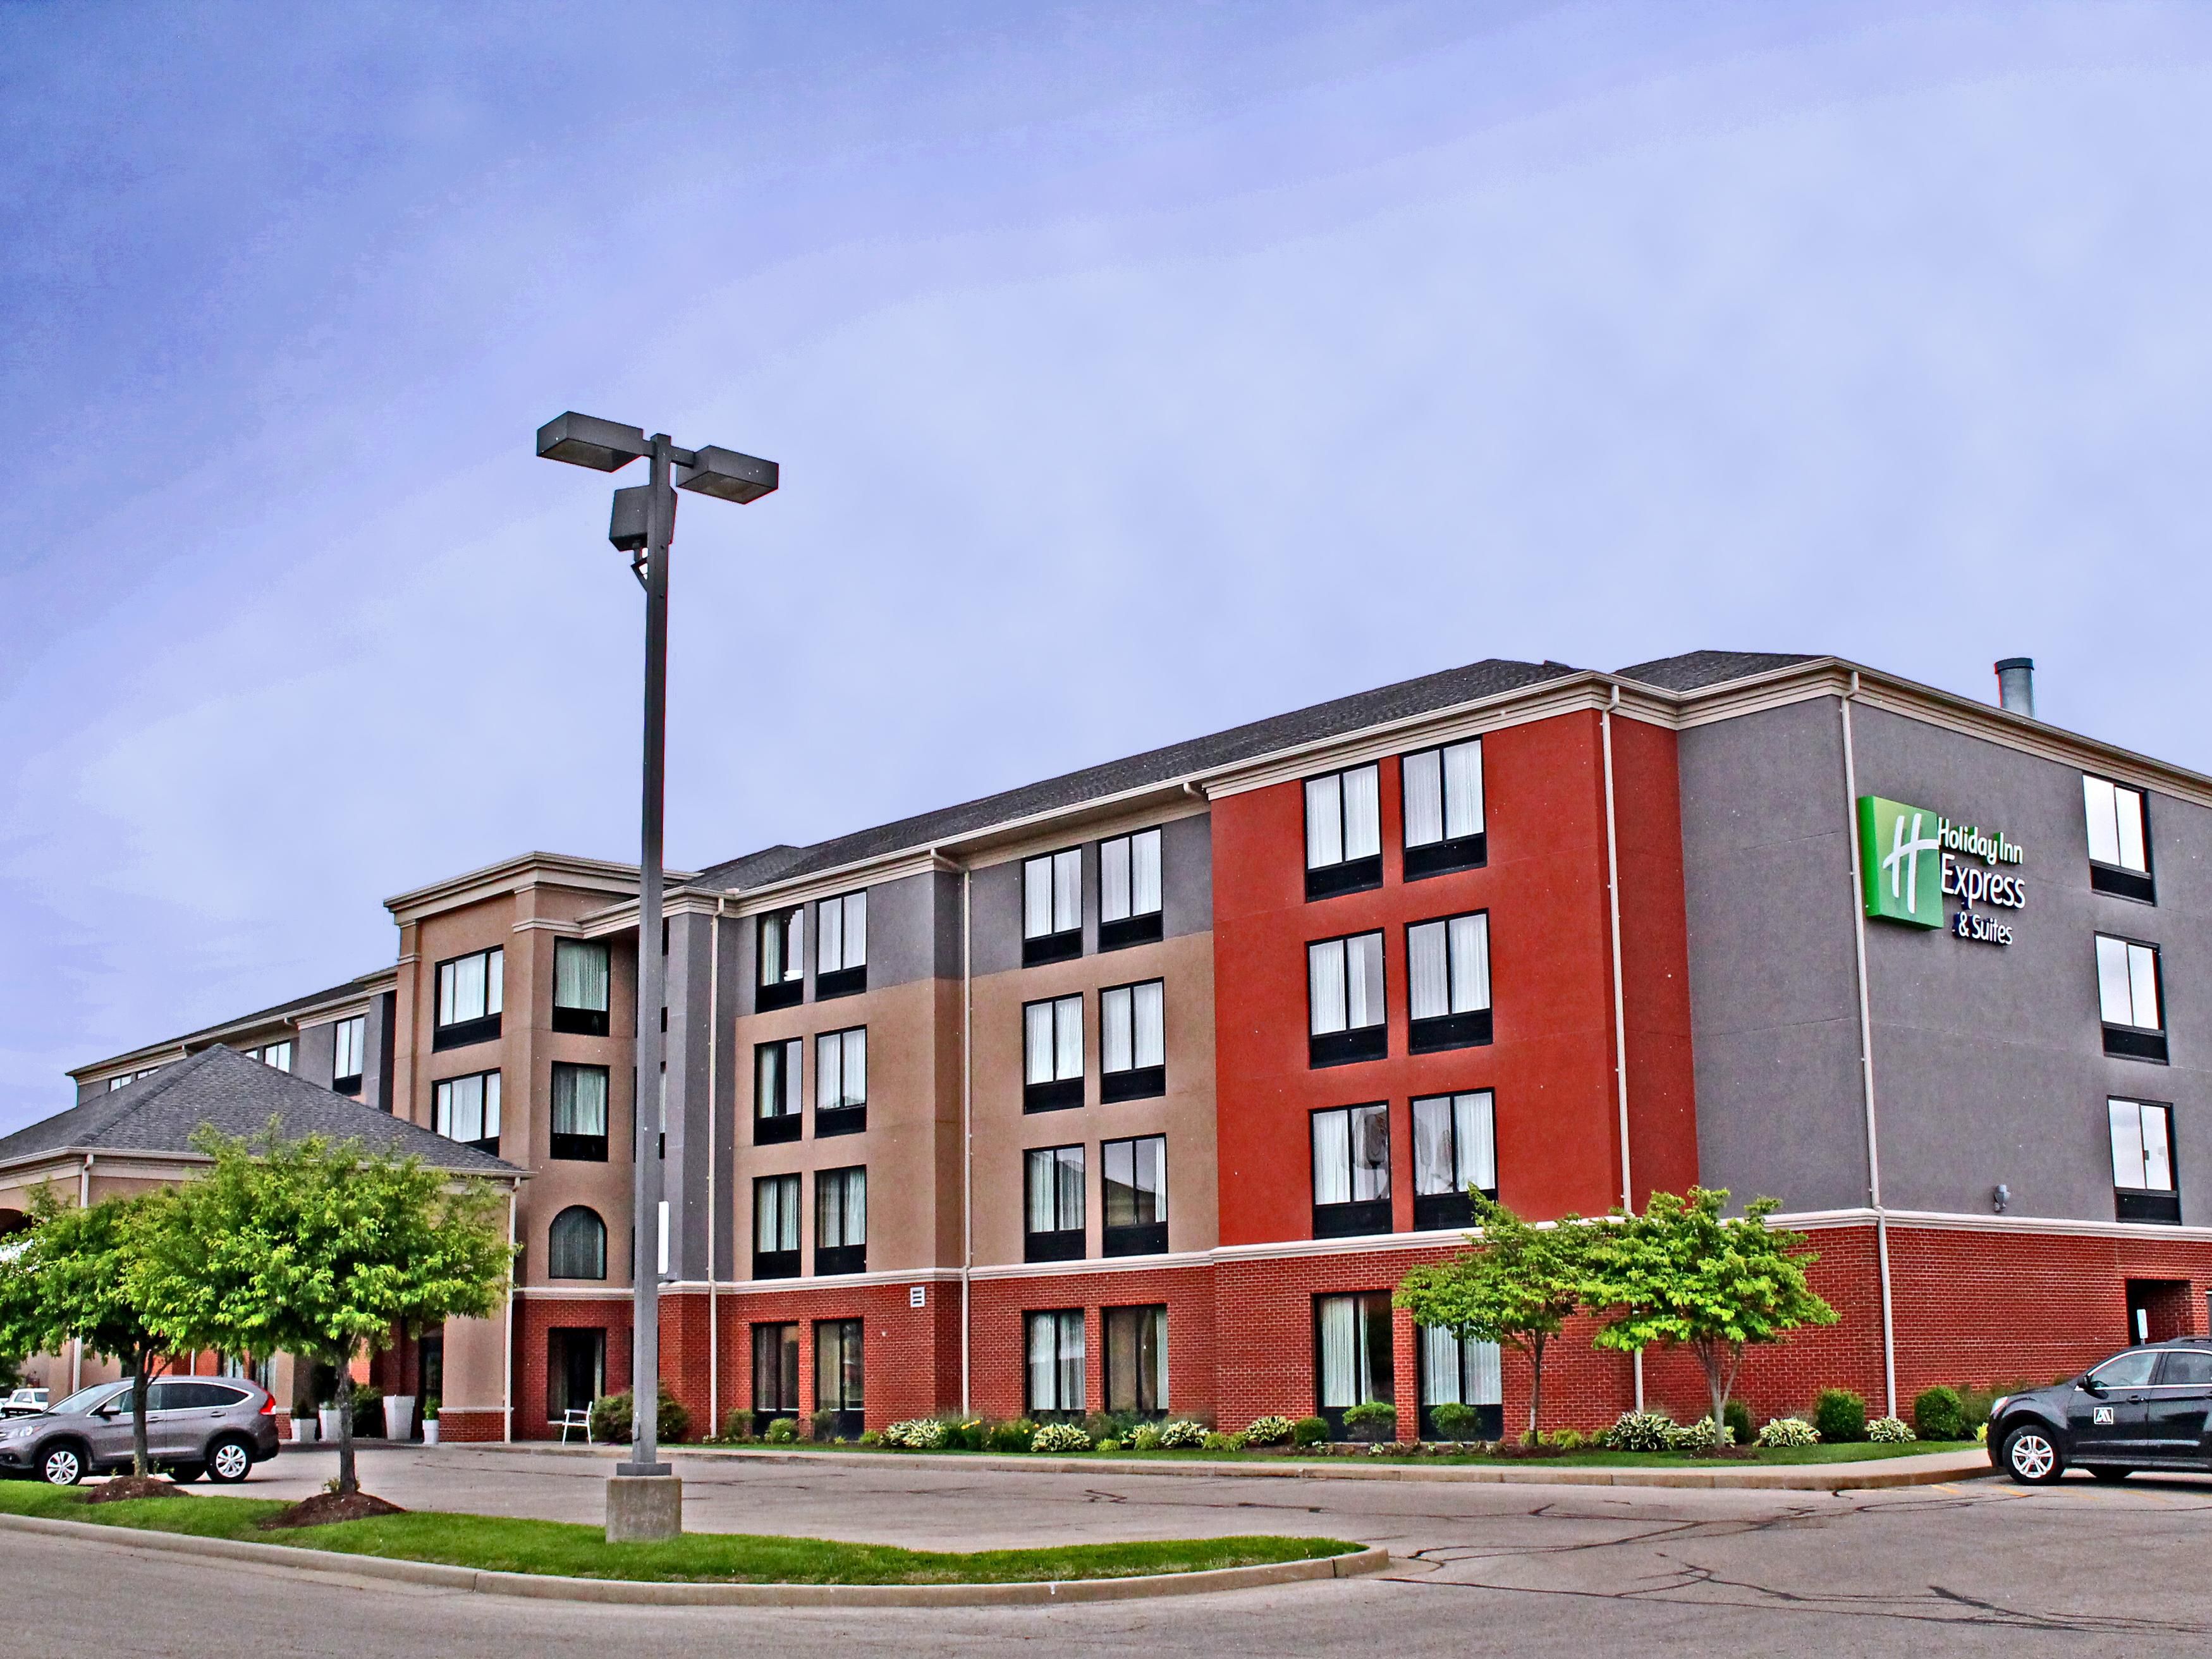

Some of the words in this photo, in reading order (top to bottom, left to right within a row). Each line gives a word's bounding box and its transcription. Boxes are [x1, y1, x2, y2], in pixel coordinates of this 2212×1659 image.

[1938, 817, 1998, 865] Holiday
[1999, 831, 2023, 864] Inn
[1941, 852, 2026, 909] Express
[1958, 911, 1969, 937] &
[1972, 914, 2013, 945] Suites
